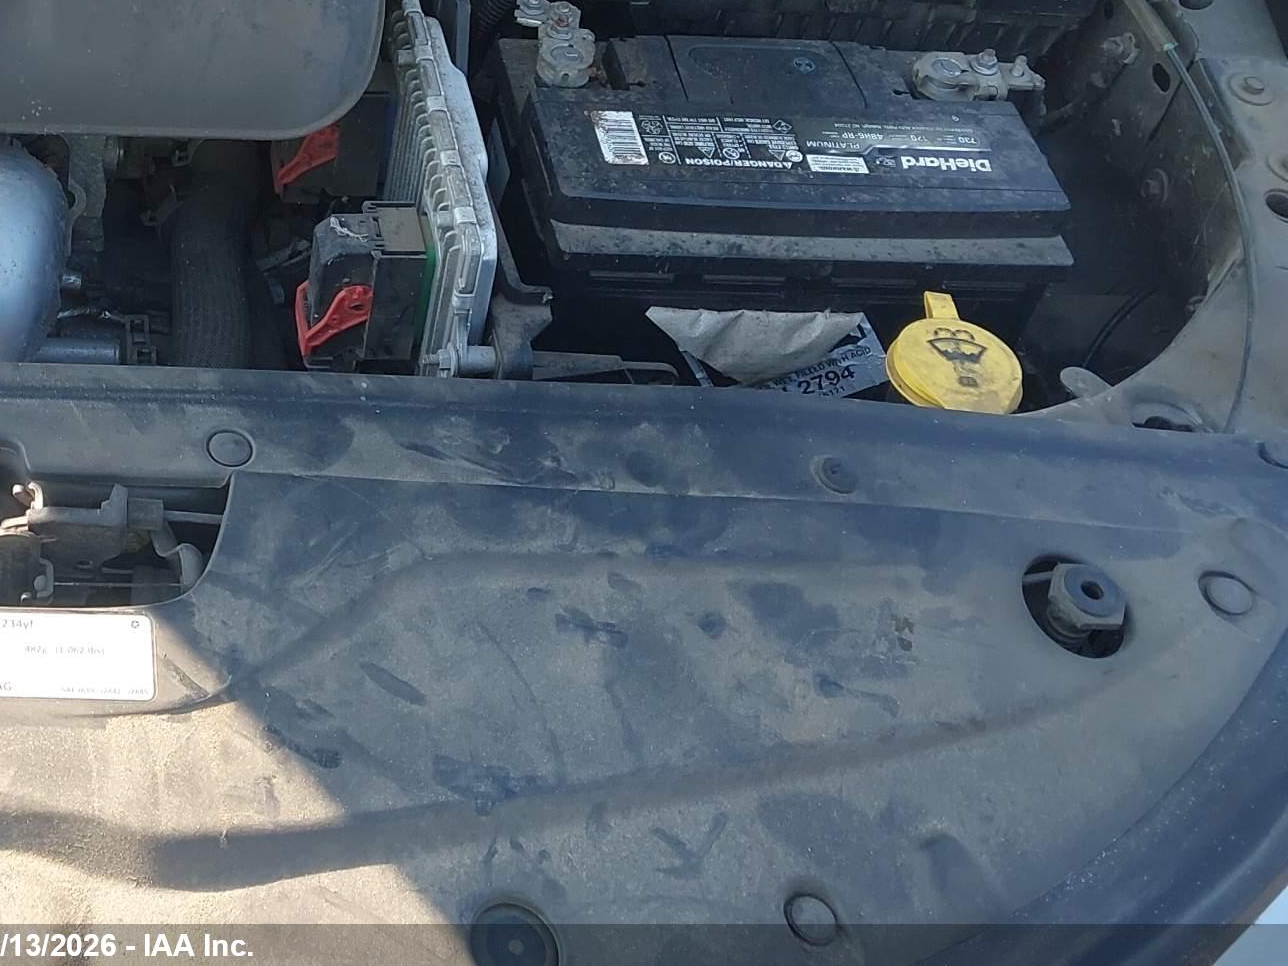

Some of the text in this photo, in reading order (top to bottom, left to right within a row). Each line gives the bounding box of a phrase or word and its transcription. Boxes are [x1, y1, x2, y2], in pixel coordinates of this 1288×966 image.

[806, 140, 860, 149] PLATINUM
[958, 136, 977, 144] 730
[685, 157, 784, 168] DANGER/POISON
[900, 155, 992, 172] DieHard
[850, 346, 871, 359] ACID
[797, 366, 856, 394] 2794
